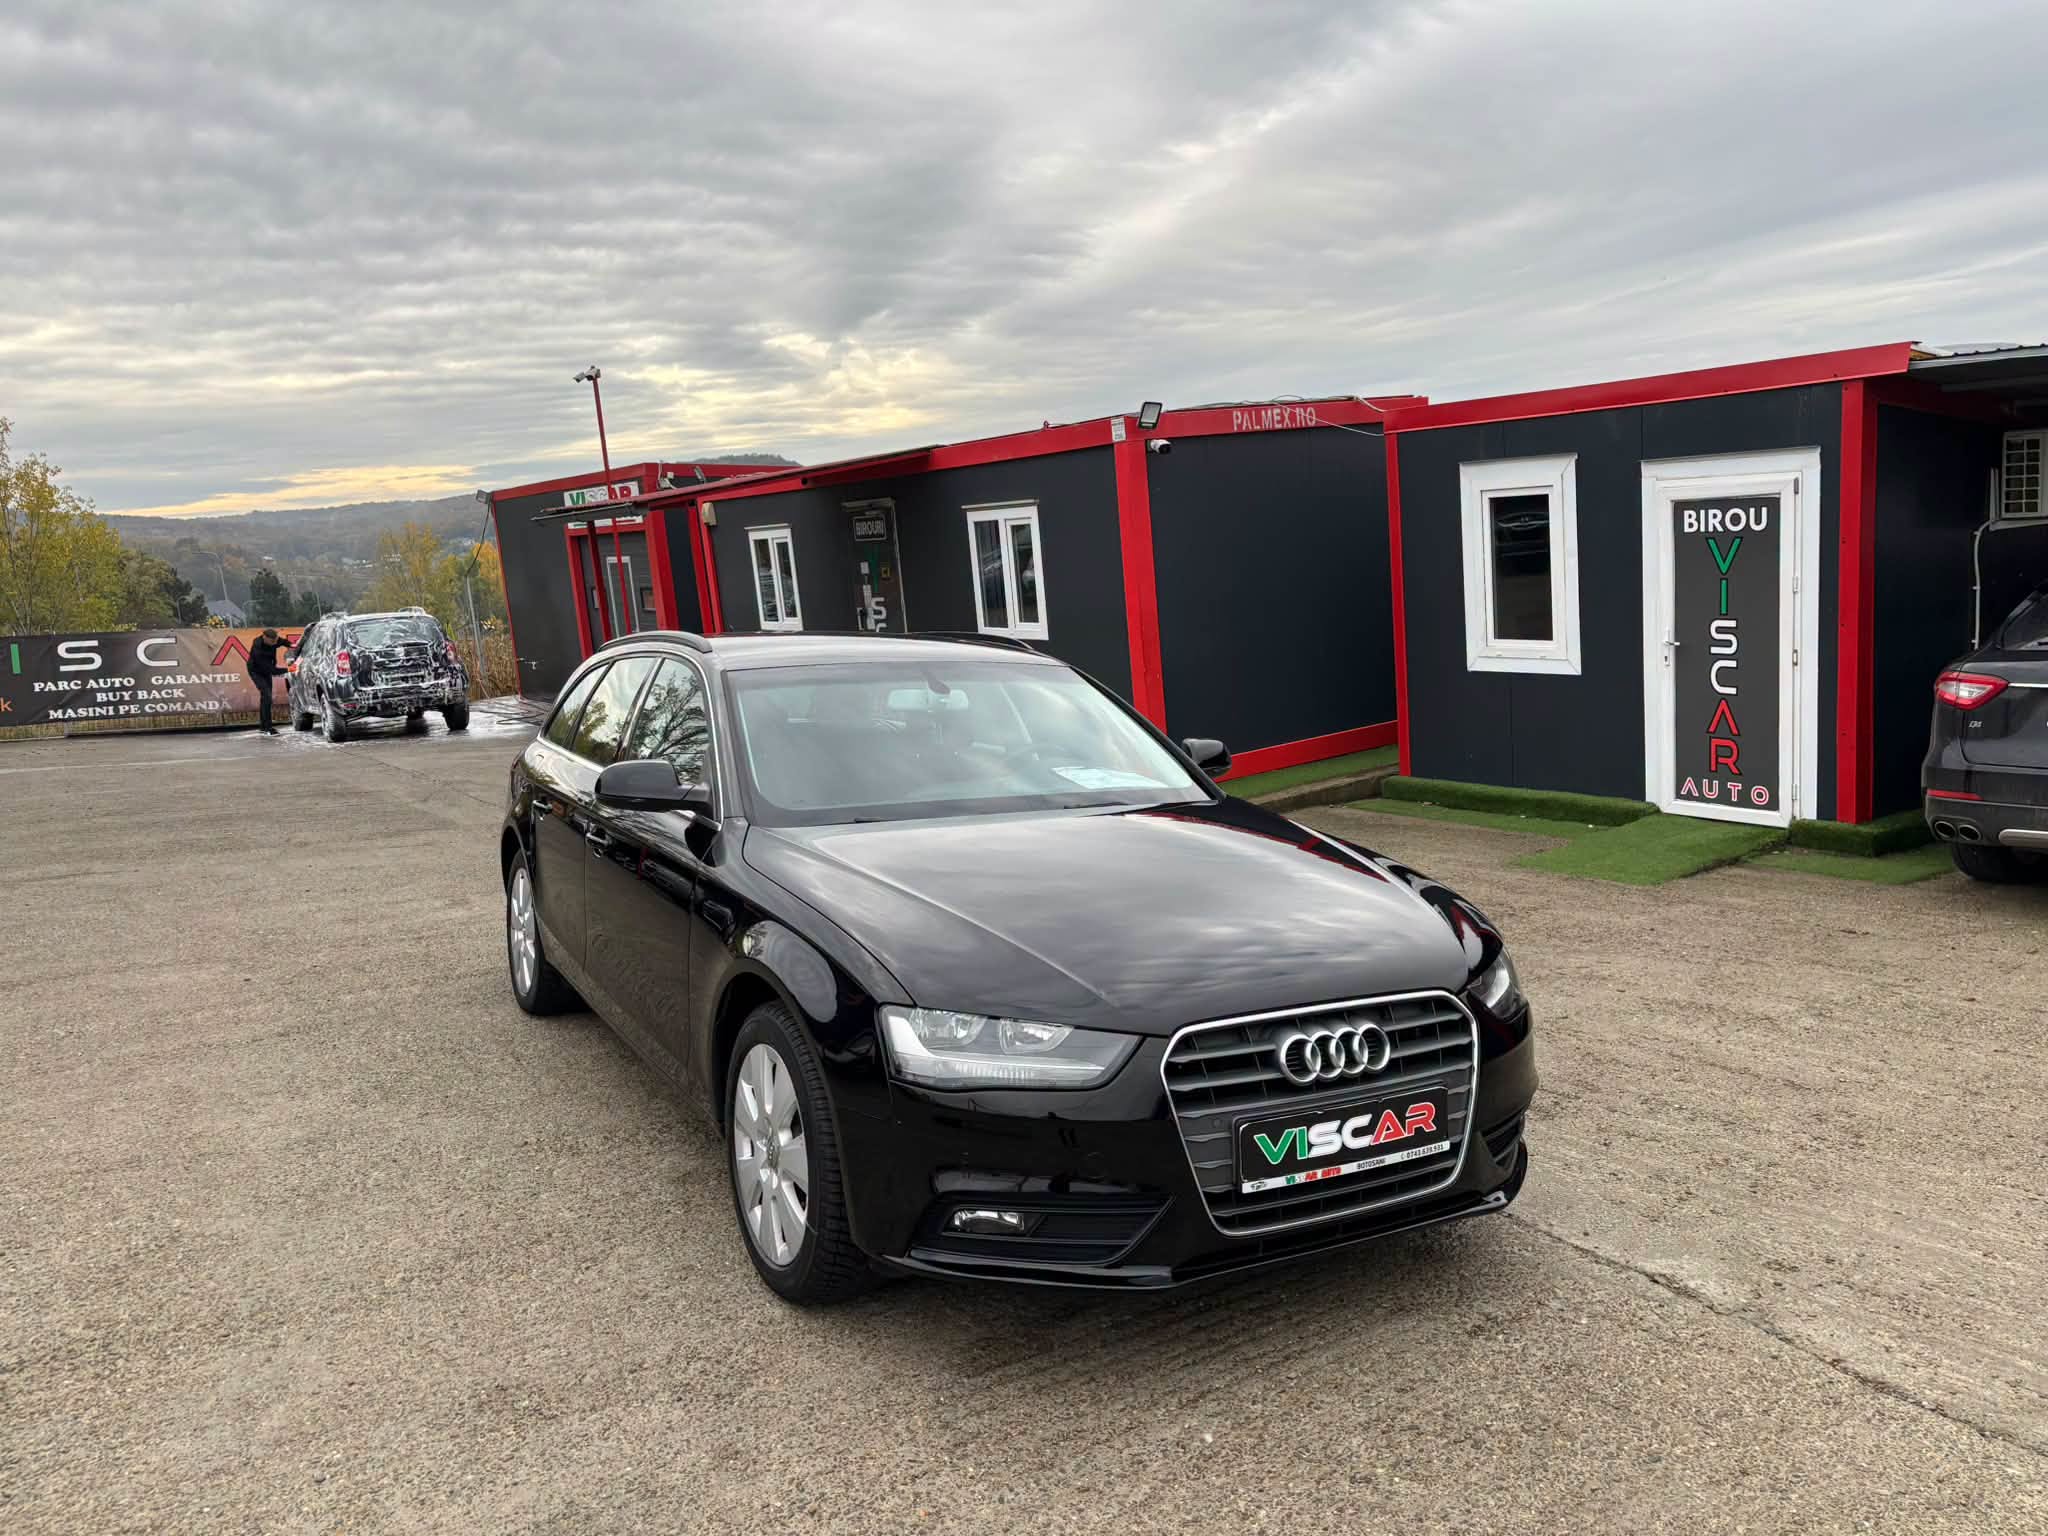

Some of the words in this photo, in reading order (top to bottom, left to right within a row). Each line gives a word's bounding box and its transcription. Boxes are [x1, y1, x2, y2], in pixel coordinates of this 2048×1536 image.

[1232, 407, 1317, 432] PALMEX.RO
[1683, 507, 1768, 533] BIROU
[1706, 536, 1742, 776] VISCAR
[33, 680, 82, 692] PARC
[86, 677, 136, 689] AUTO
[151, 673, 241, 685] GARANTIE
[95, 690, 133, 703] BUY
[137, 688, 186, 701] BACK
[48, 705, 116, 720] MASINI
[118, 703, 141, 715] PE
[1680, 776, 1770, 806] AUTO
[1253, 1102, 1437, 1165] VISCAR
